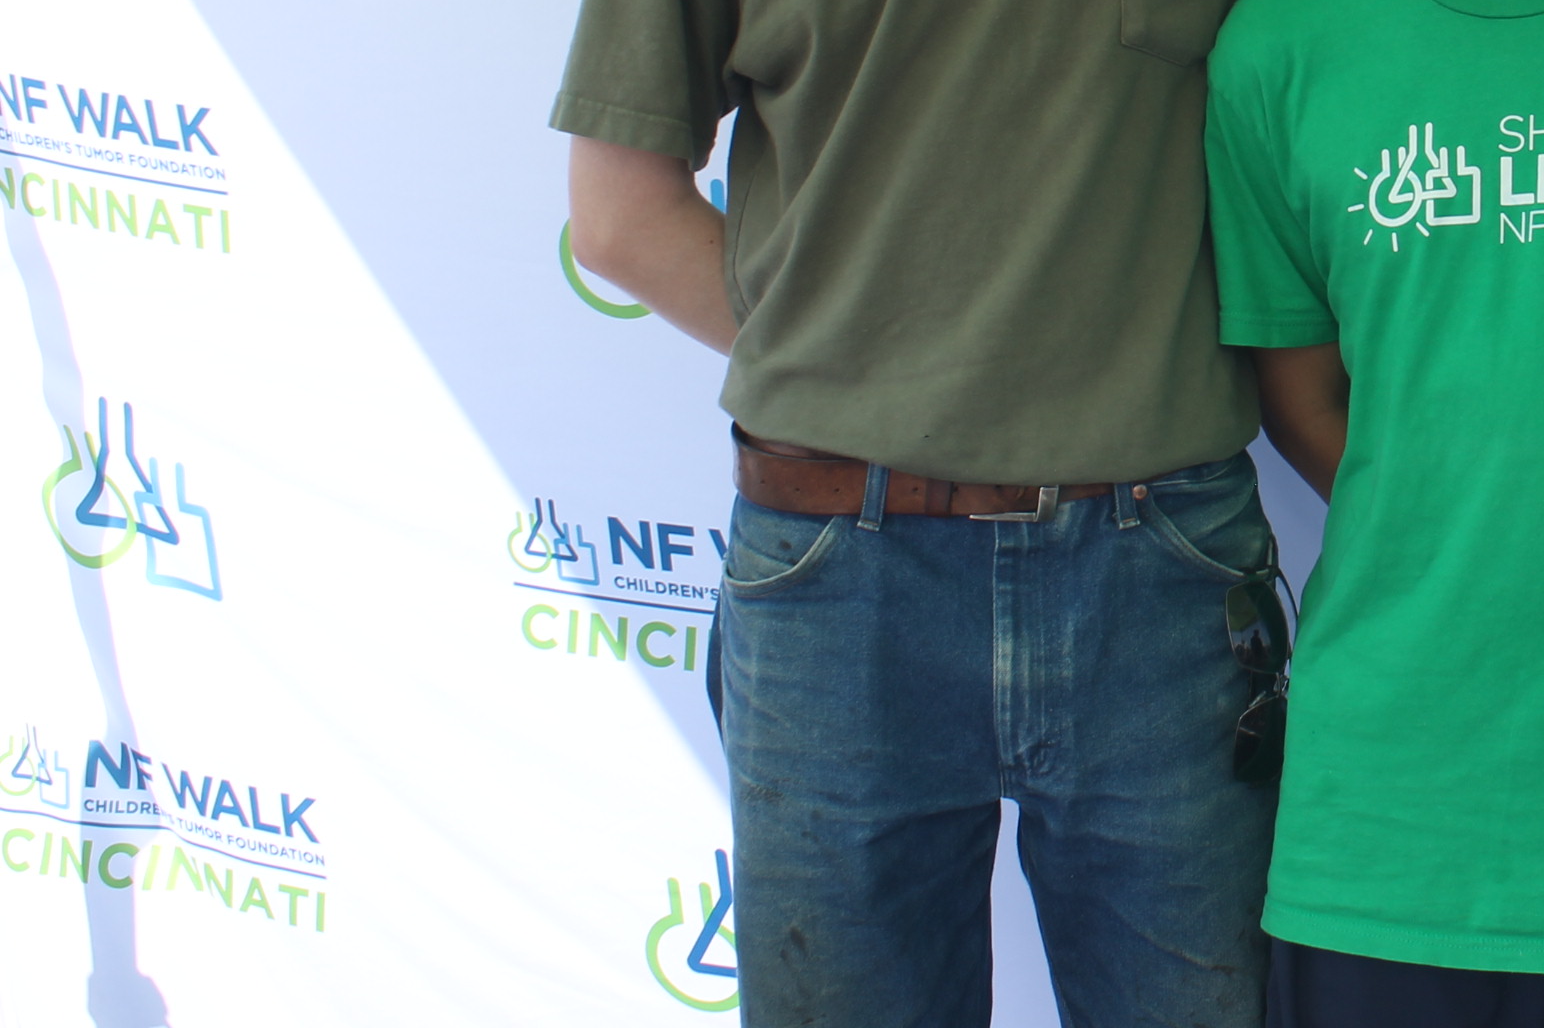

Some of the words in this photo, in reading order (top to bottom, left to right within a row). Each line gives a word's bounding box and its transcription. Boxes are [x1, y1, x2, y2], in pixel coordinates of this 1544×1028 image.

[56, 83, 220, 156] WALK
[76, 144, 124, 164] TUMOR
[129, 154, 227, 180] FOUNDATION
[607, 515, 695, 572] NF
[614, 576, 720, 600] CHILDREN'S
[521, 604, 711, 672] CINCI
[85, 739, 153, 790] NF
[161, 762, 320, 844] WALK
[177, 818, 223, 843] TUMOR
[227, 835, 326, 866] FOUNDATION
[2, 828, 326, 932] CINCINNATI
